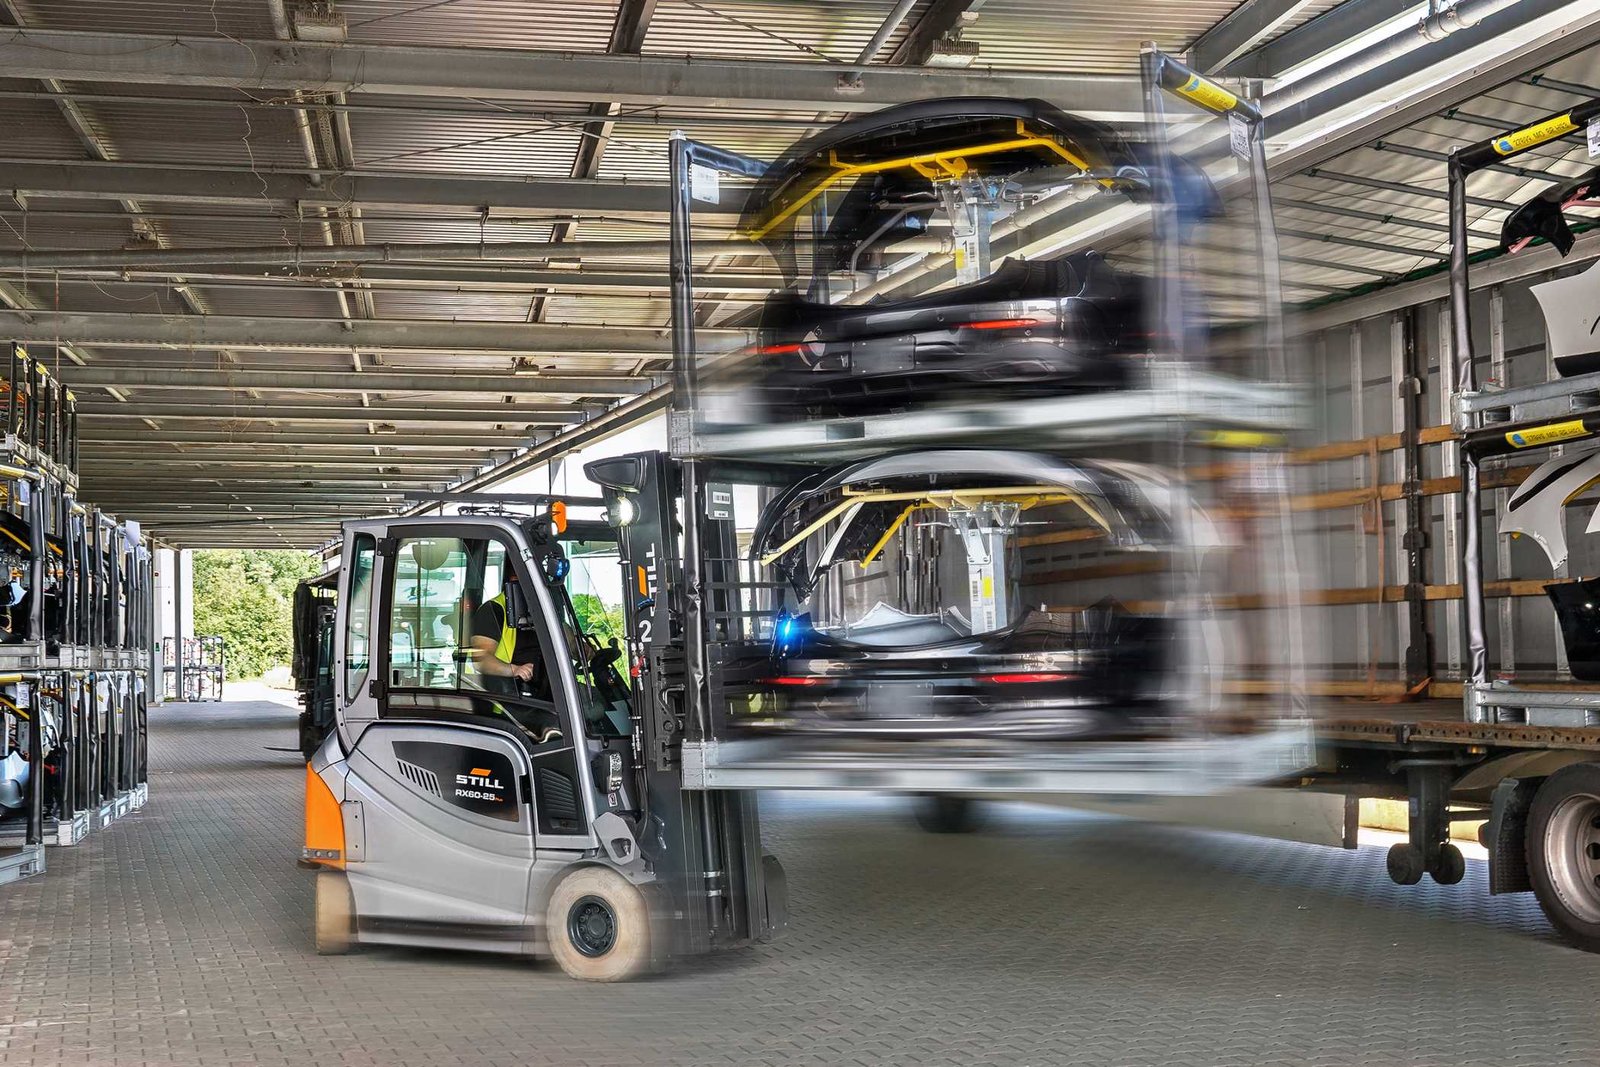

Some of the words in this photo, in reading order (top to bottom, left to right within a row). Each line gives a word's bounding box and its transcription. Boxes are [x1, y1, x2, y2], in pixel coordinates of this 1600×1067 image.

[639, 619, 652, 643] 2
[455, 774, 504, 790] STILL
[455, 789, 496, 801] RX60-25
